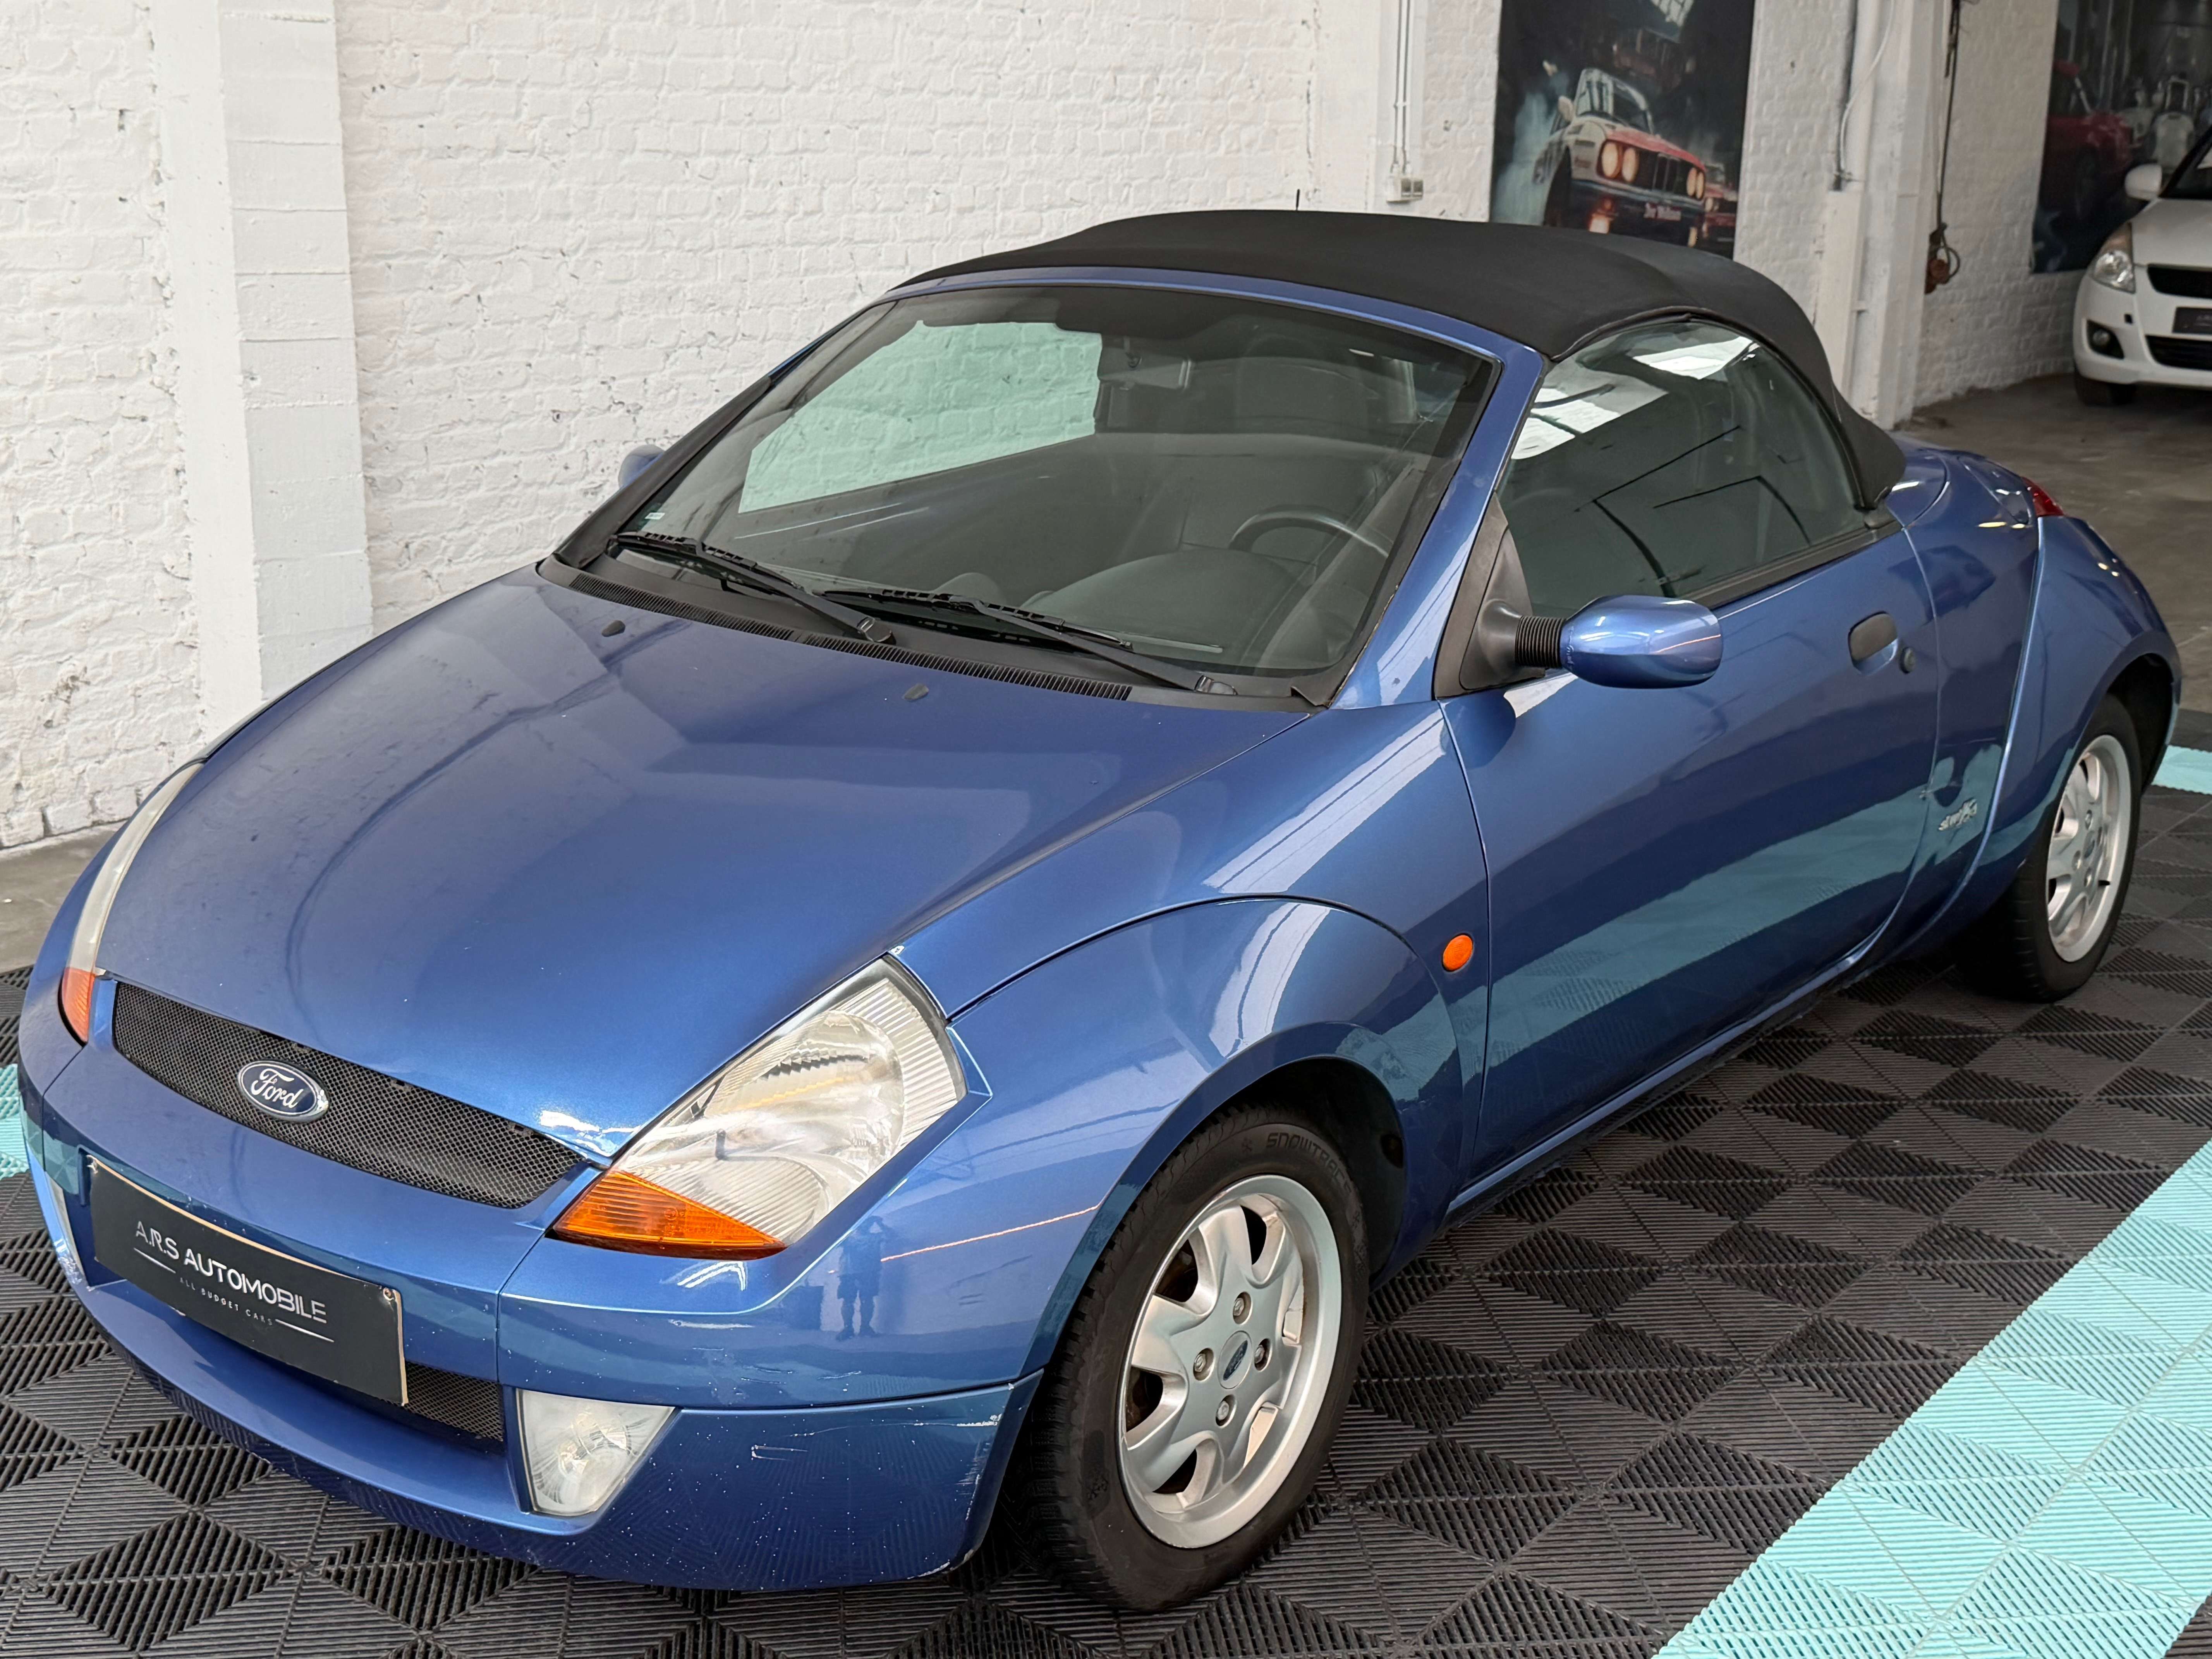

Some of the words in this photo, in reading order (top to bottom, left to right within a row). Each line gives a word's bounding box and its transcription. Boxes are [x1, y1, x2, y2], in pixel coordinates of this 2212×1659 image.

[251, 1068, 304, 1108] Ford
[136, 1221, 179, 1259] A.R.S
[184, 1248, 327, 1324] AUTOMOBILE
[180, 1277, 195, 1290] ALL
[201, 1288, 239, 1311] BUDGET
[246, 1309, 272, 1326] CARS
